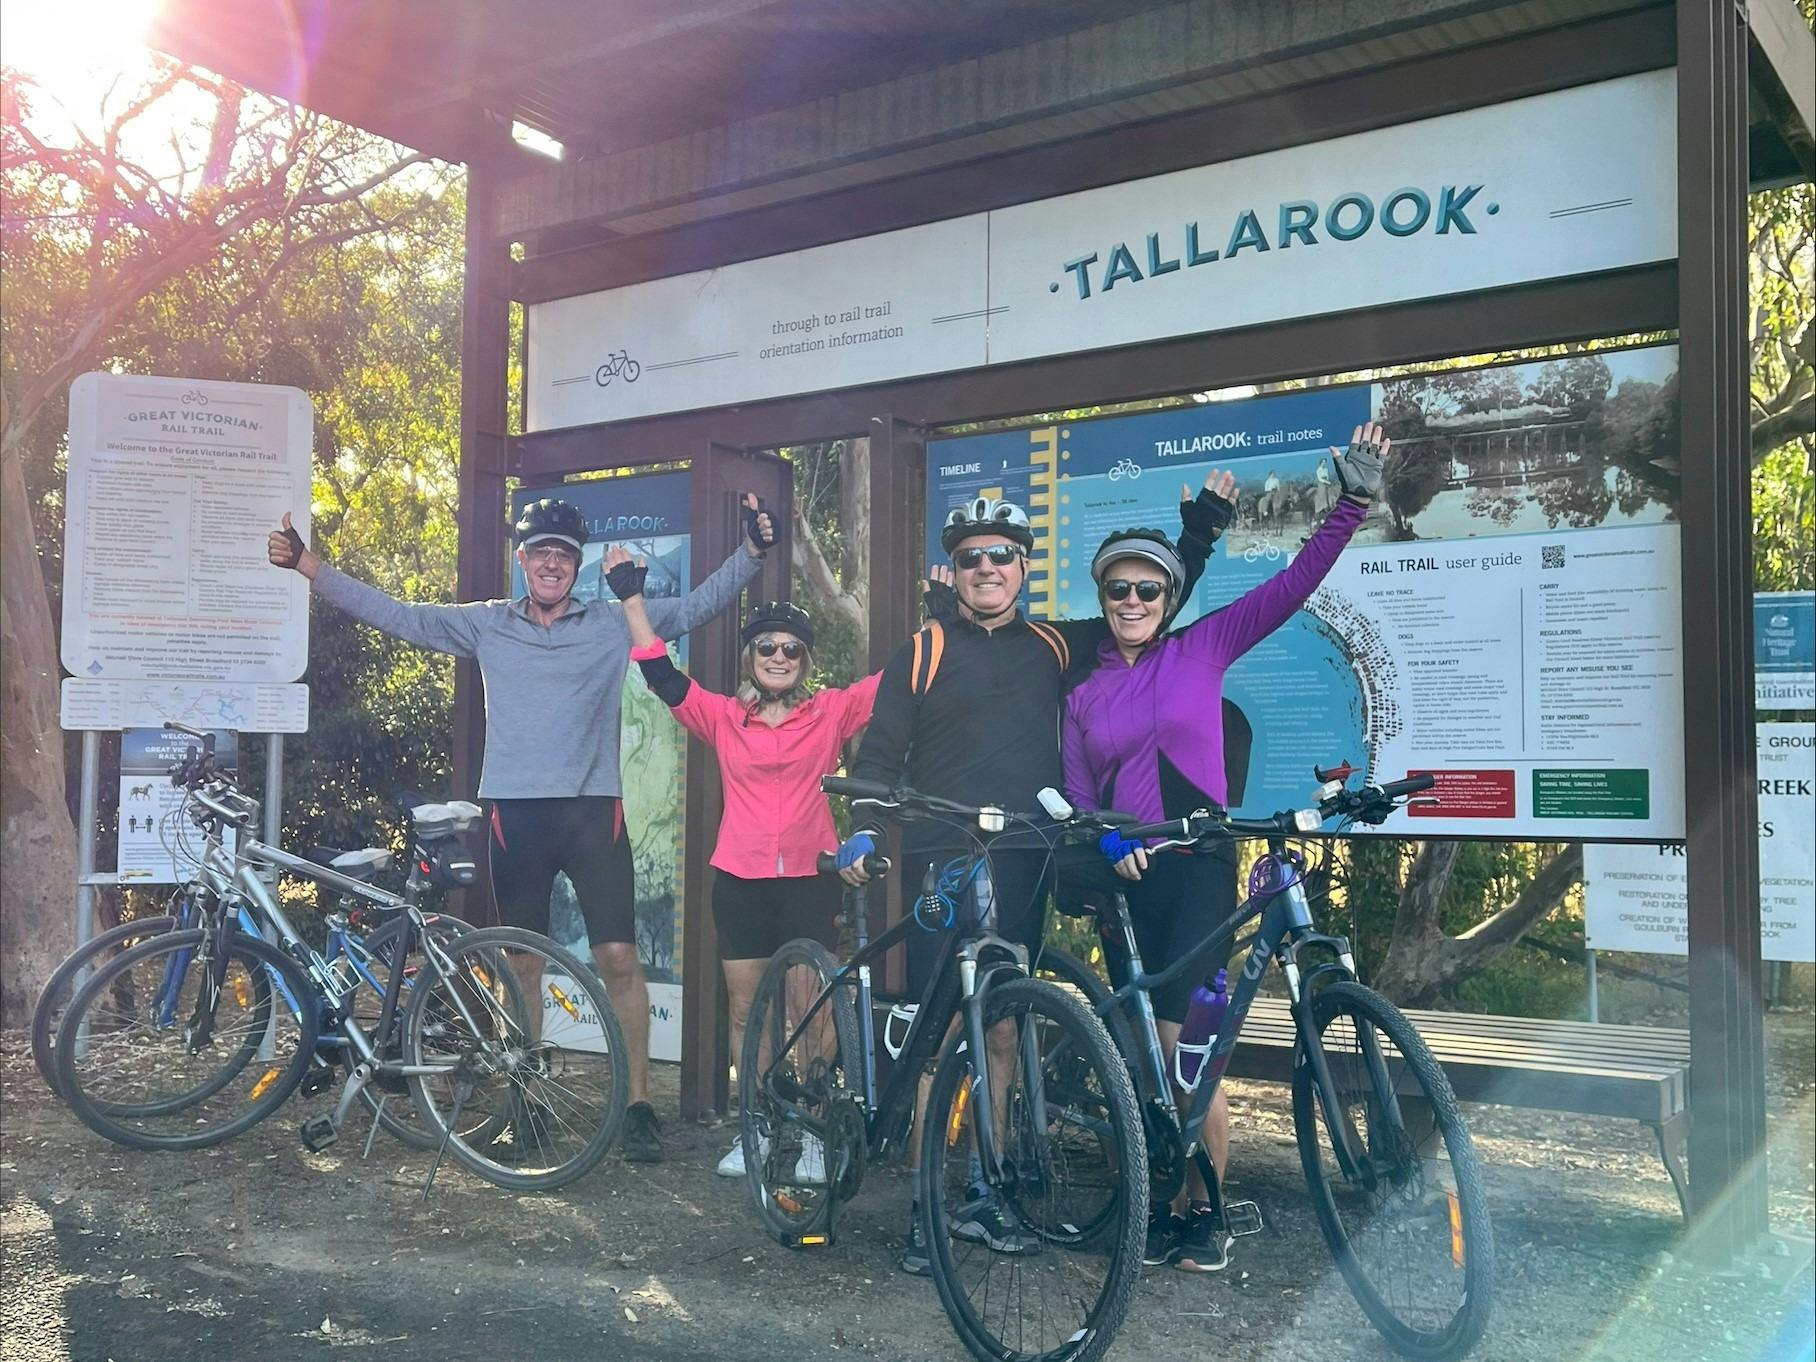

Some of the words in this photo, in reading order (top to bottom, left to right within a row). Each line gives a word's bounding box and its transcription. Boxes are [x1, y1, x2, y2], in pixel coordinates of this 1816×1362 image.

[1063, 184, 1486, 300] TALLAROOK
[772, 312, 820, 335] through
[823, 313, 836, 326] to
[840, 306, 861, 322] rail
[864, 301, 891, 319] trail
[759, 338, 825, 360] orientation
[828, 323, 904, 348] information
[128, 410, 176, 423] GREAT
[182, 410, 259, 431] VICTORIAN
[161, 423, 188, 434] RAIL
[191, 426, 225, 437] TRAIL
[1155, 431, 1251, 457] TALLAROOK:
[1257, 430, 1284, 445] trail
[1287, 427, 1323, 442] notes
[106, 442, 146, 452] Welcome
[148, 445, 158, 453] to
[159, 446, 173, 454] the
[175, 447, 199, 456] Great
[200, 448, 238, 458] Victorian
[240, 451, 256, 459] Rail
[258, 452, 277, 460] Trail
[939, 462, 981, 477] TIMELINE
[584, 515, 664, 534] LLAROOK
[1360, 561, 1392, 575] RAIL
[1397, 557, 1439, 573] TRAIL
[1446, 556, 1476, 570] user
[1481, 552, 1523, 571] guide
[1756, 684, 1815, 699] nitiative
[1760, 754, 1788, 762] TRUST
[1758, 779, 1812, 796] REEK
[1603, 872, 1664, 882] PRESERVATION
[1666, 873, 1680, 882] OF
[1618, 890, 1671, 900] RESTORATION
[1774, 897, 1798, 906] TREE
[1641, 900, 1661, 909] AND
[1619, 914, 1660, 924] CREATION
[1663, 916, 1676, 924] OF
[1770, 922, 1797, 930] FROM
[1633, 923, 1680, 932] GOULBURN
[543, 994, 587, 1010] GRAT
